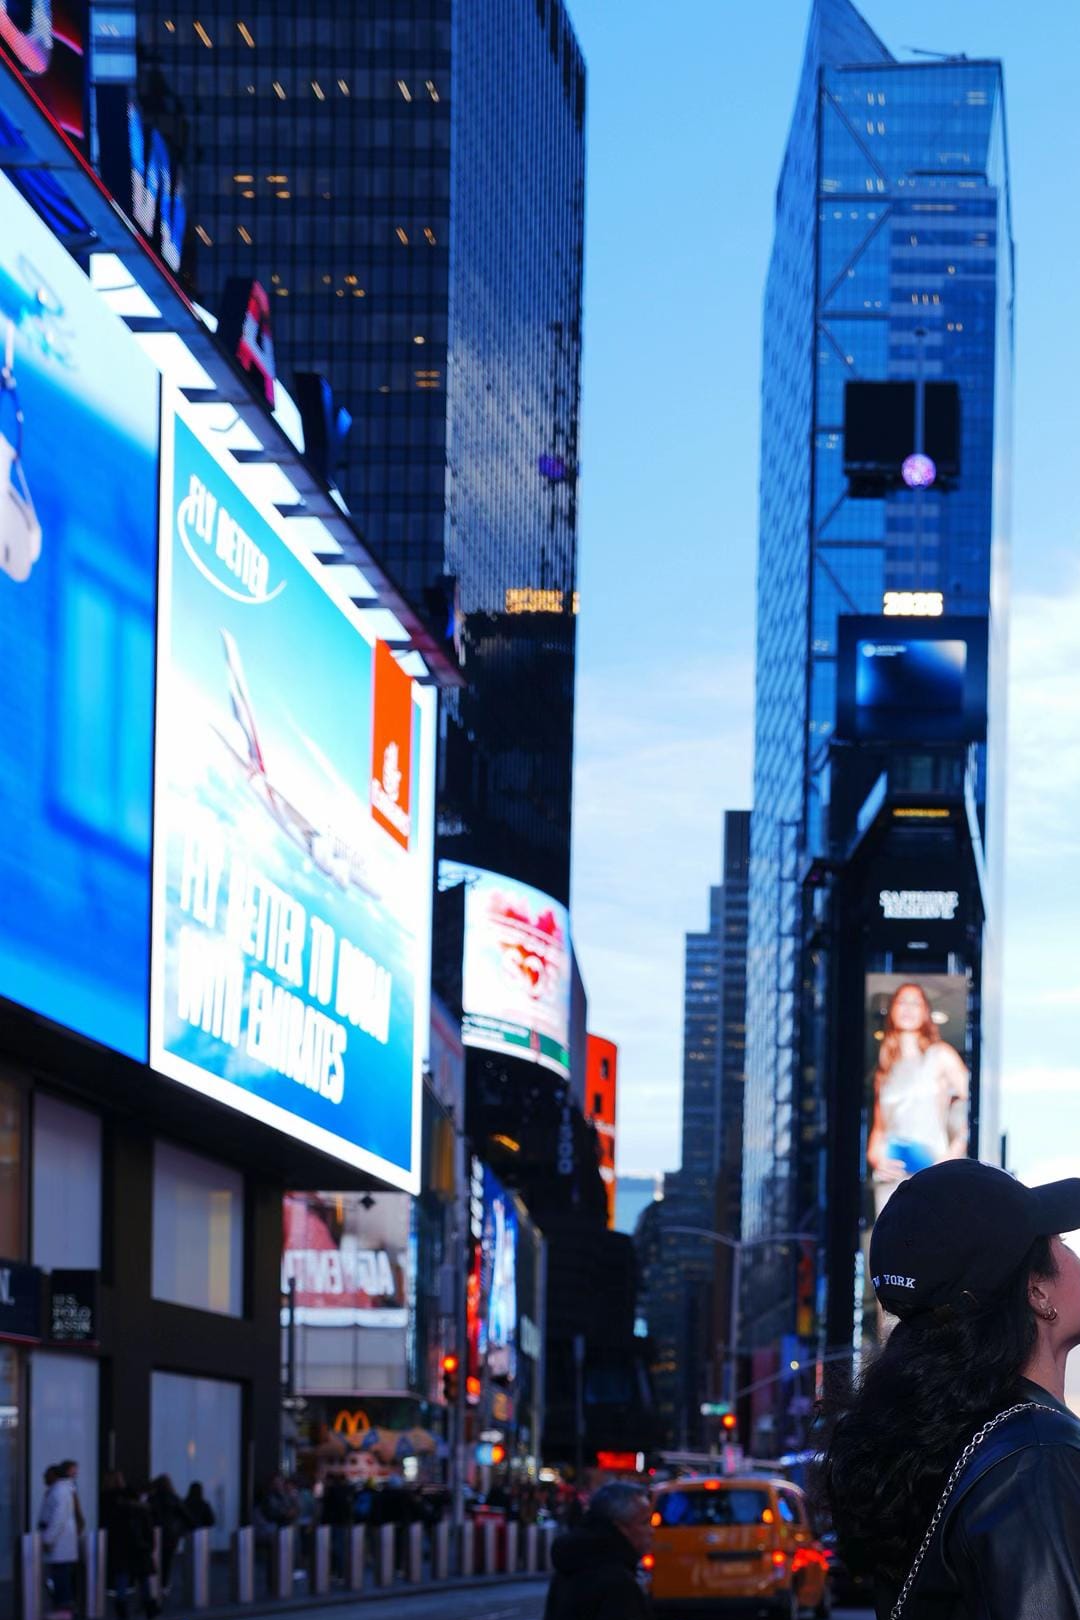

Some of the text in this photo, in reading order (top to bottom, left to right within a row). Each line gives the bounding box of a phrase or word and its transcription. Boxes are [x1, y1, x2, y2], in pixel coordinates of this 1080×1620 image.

[187, 473, 269, 598] FLY BETTER
[883, 1275, 916, 1289] YORK
